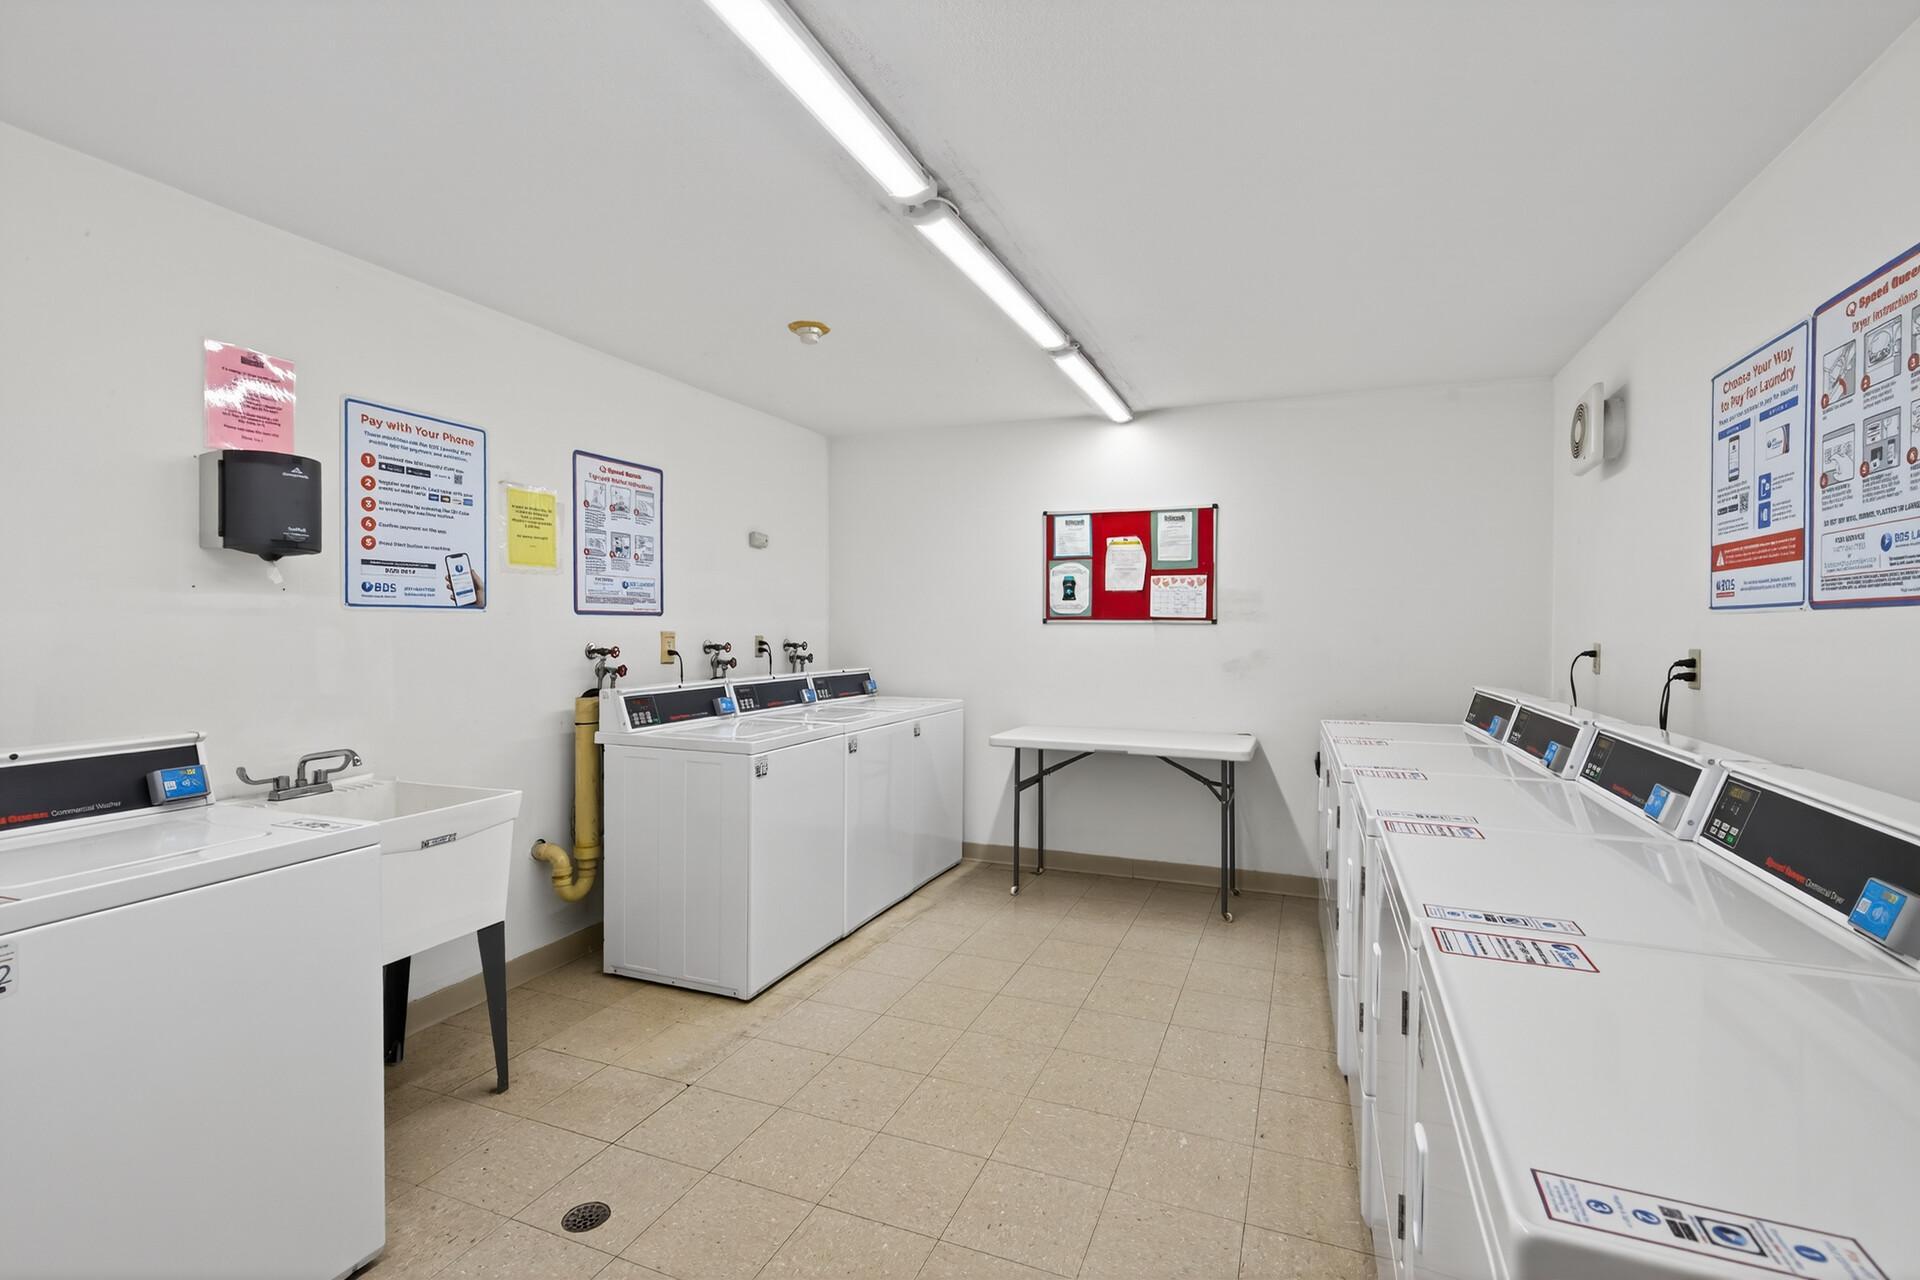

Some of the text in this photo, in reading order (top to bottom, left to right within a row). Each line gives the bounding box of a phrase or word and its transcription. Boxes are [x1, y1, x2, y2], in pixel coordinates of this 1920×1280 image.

[1752, 359, 1772, 377] Your
[1773, 346, 1794, 365] Way
[1730, 393, 1744, 408] Pay
[1746, 386, 1758, 400] for
[1759, 366, 1796, 393] Laundry
[361, 414, 383, 429] Pay
[386, 421, 412, 433] with
[415, 425, 440, 440] Your
[374, 582, 397, 593] BDS
